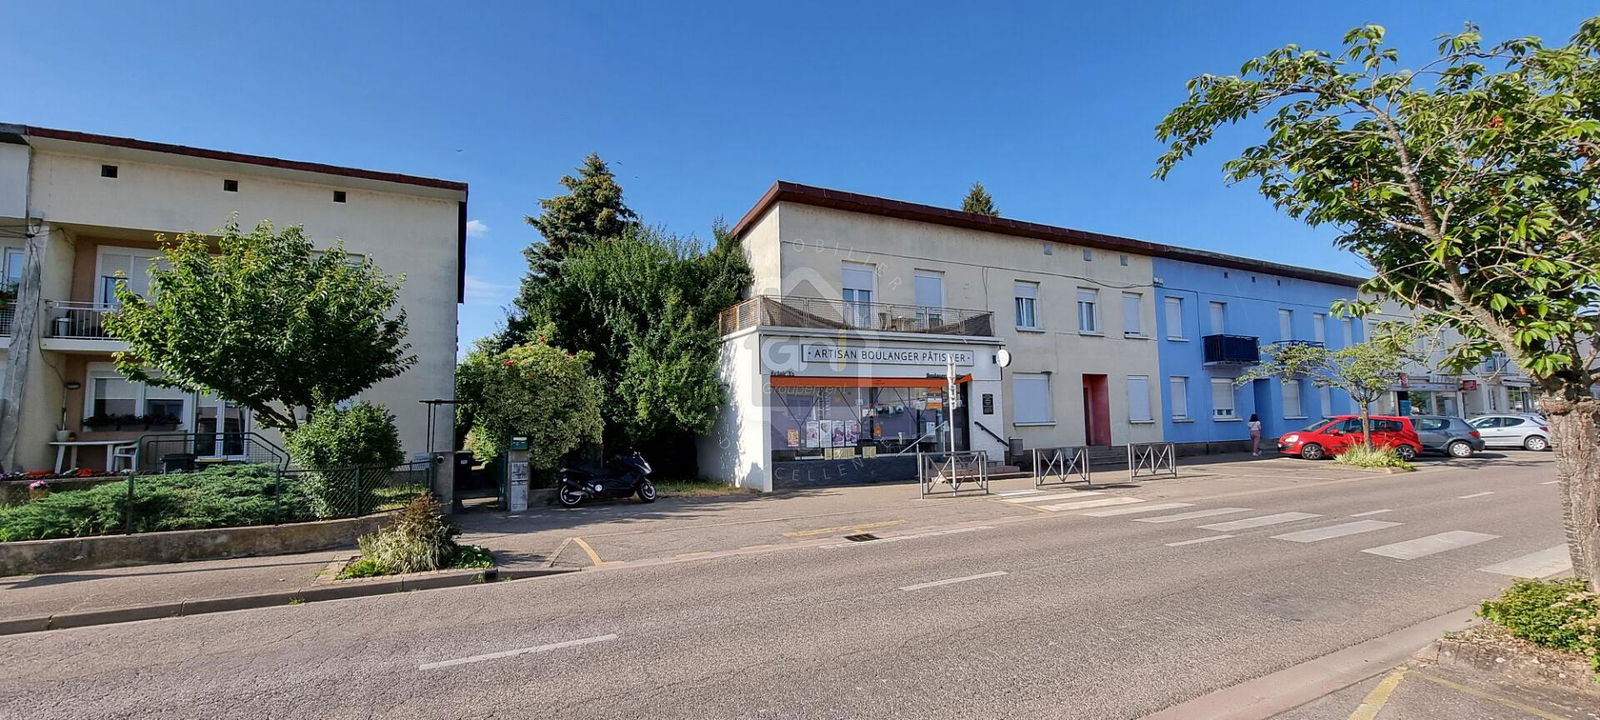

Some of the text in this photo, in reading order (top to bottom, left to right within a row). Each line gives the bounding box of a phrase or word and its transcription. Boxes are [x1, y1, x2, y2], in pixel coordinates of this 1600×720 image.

[814, 348, 965, 362] ARTISAN BOULANGER PÂTISER
